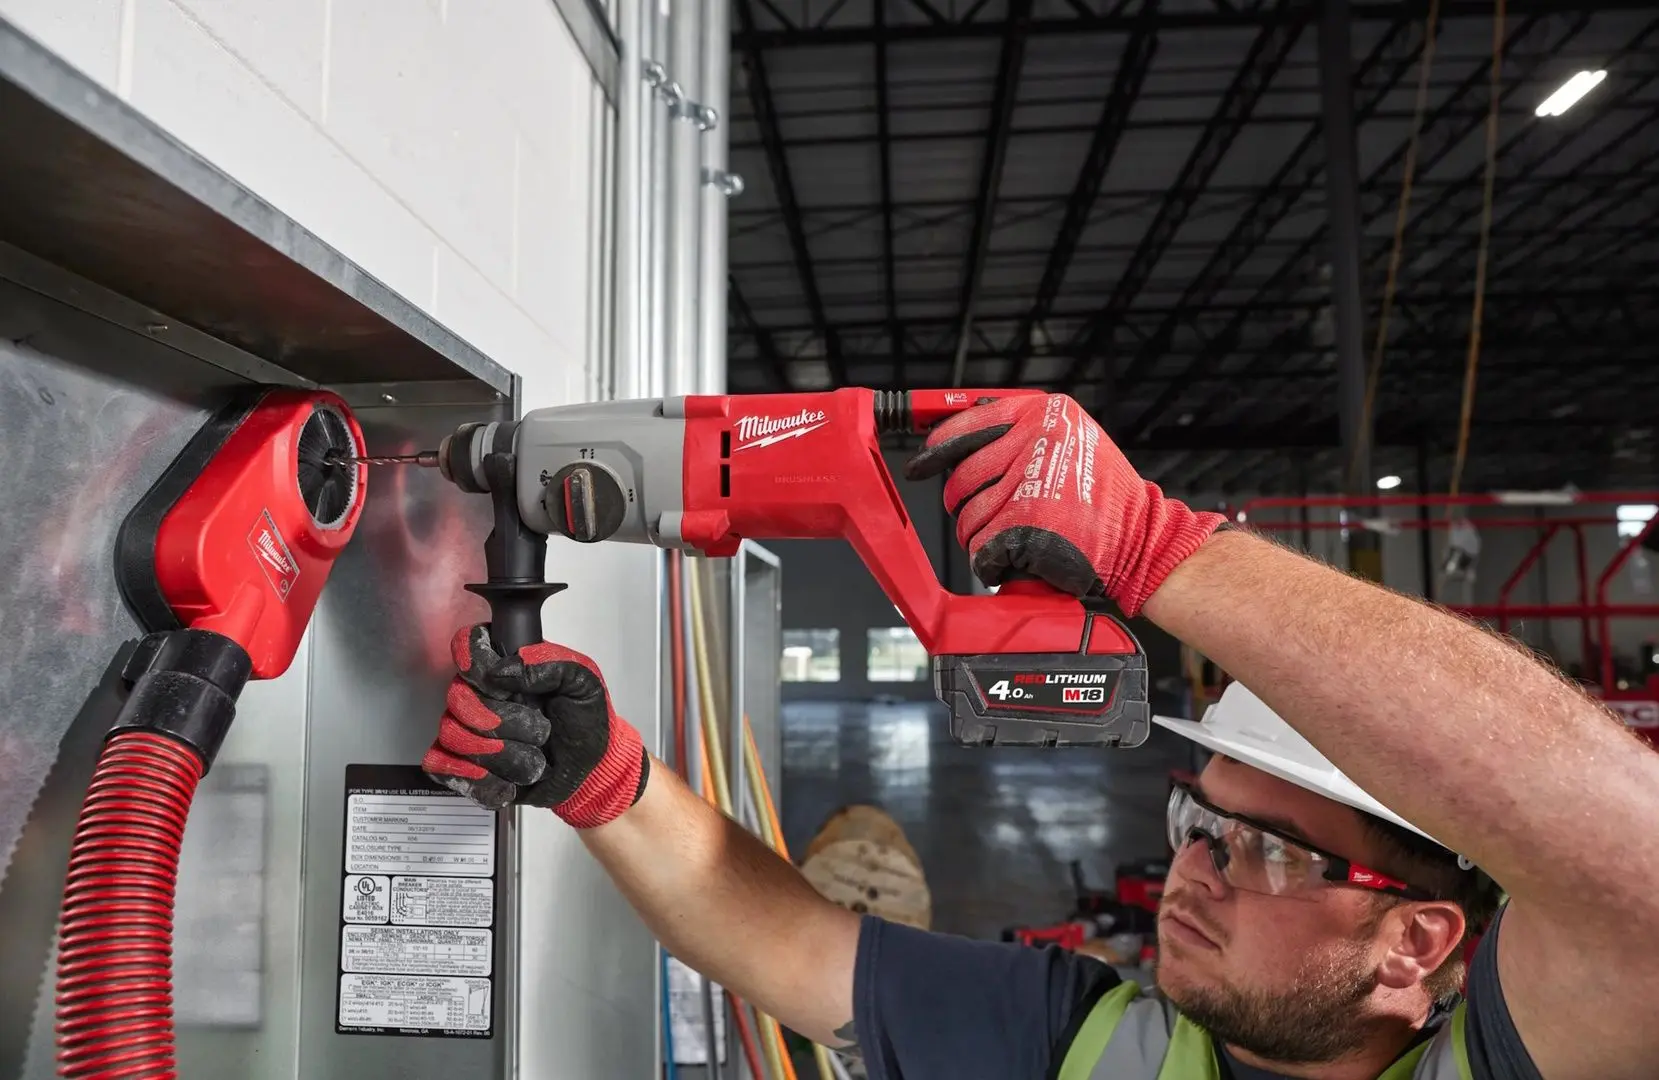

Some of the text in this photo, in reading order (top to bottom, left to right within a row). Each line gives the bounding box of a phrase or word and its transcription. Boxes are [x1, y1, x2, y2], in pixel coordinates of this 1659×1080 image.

[734, 408, 826, 442] Milwaukee
[1082, 416, 1100, 505] Milwaukee
[258, 528, 291, 574] Milwaukee
[988, 680, 1024, 700] 4.0
[1014, 674, 1107, 684] REDLITHIUM
[1064, 689, 1102, 701] M18
